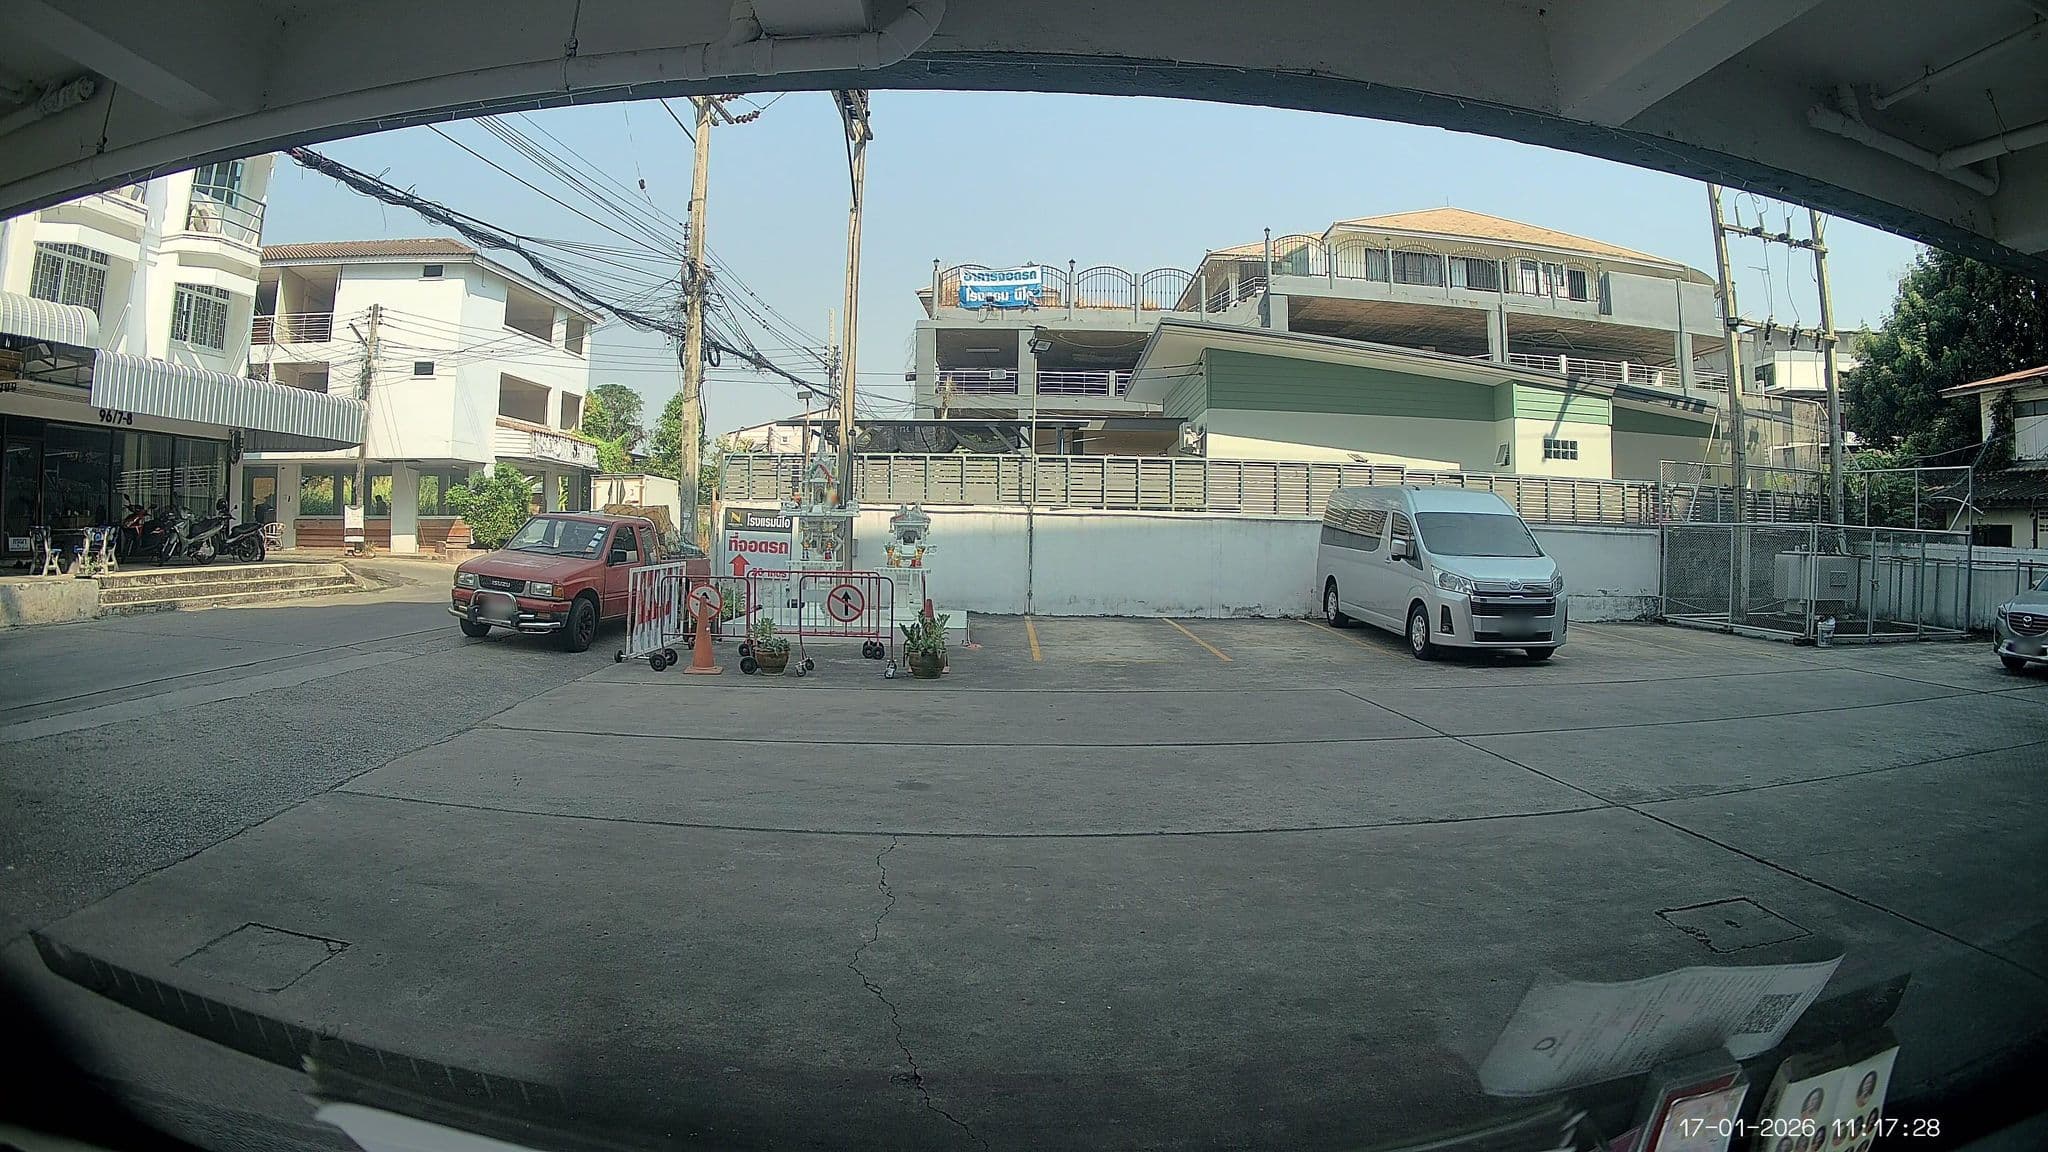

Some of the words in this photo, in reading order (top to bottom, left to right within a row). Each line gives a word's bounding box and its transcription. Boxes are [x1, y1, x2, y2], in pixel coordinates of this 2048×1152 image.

[99, 408, 133, 426] 96/7-8
[728, 532, 789, 554] ที่จอดรถ
[491, 580, 511, 588] ISUZU
